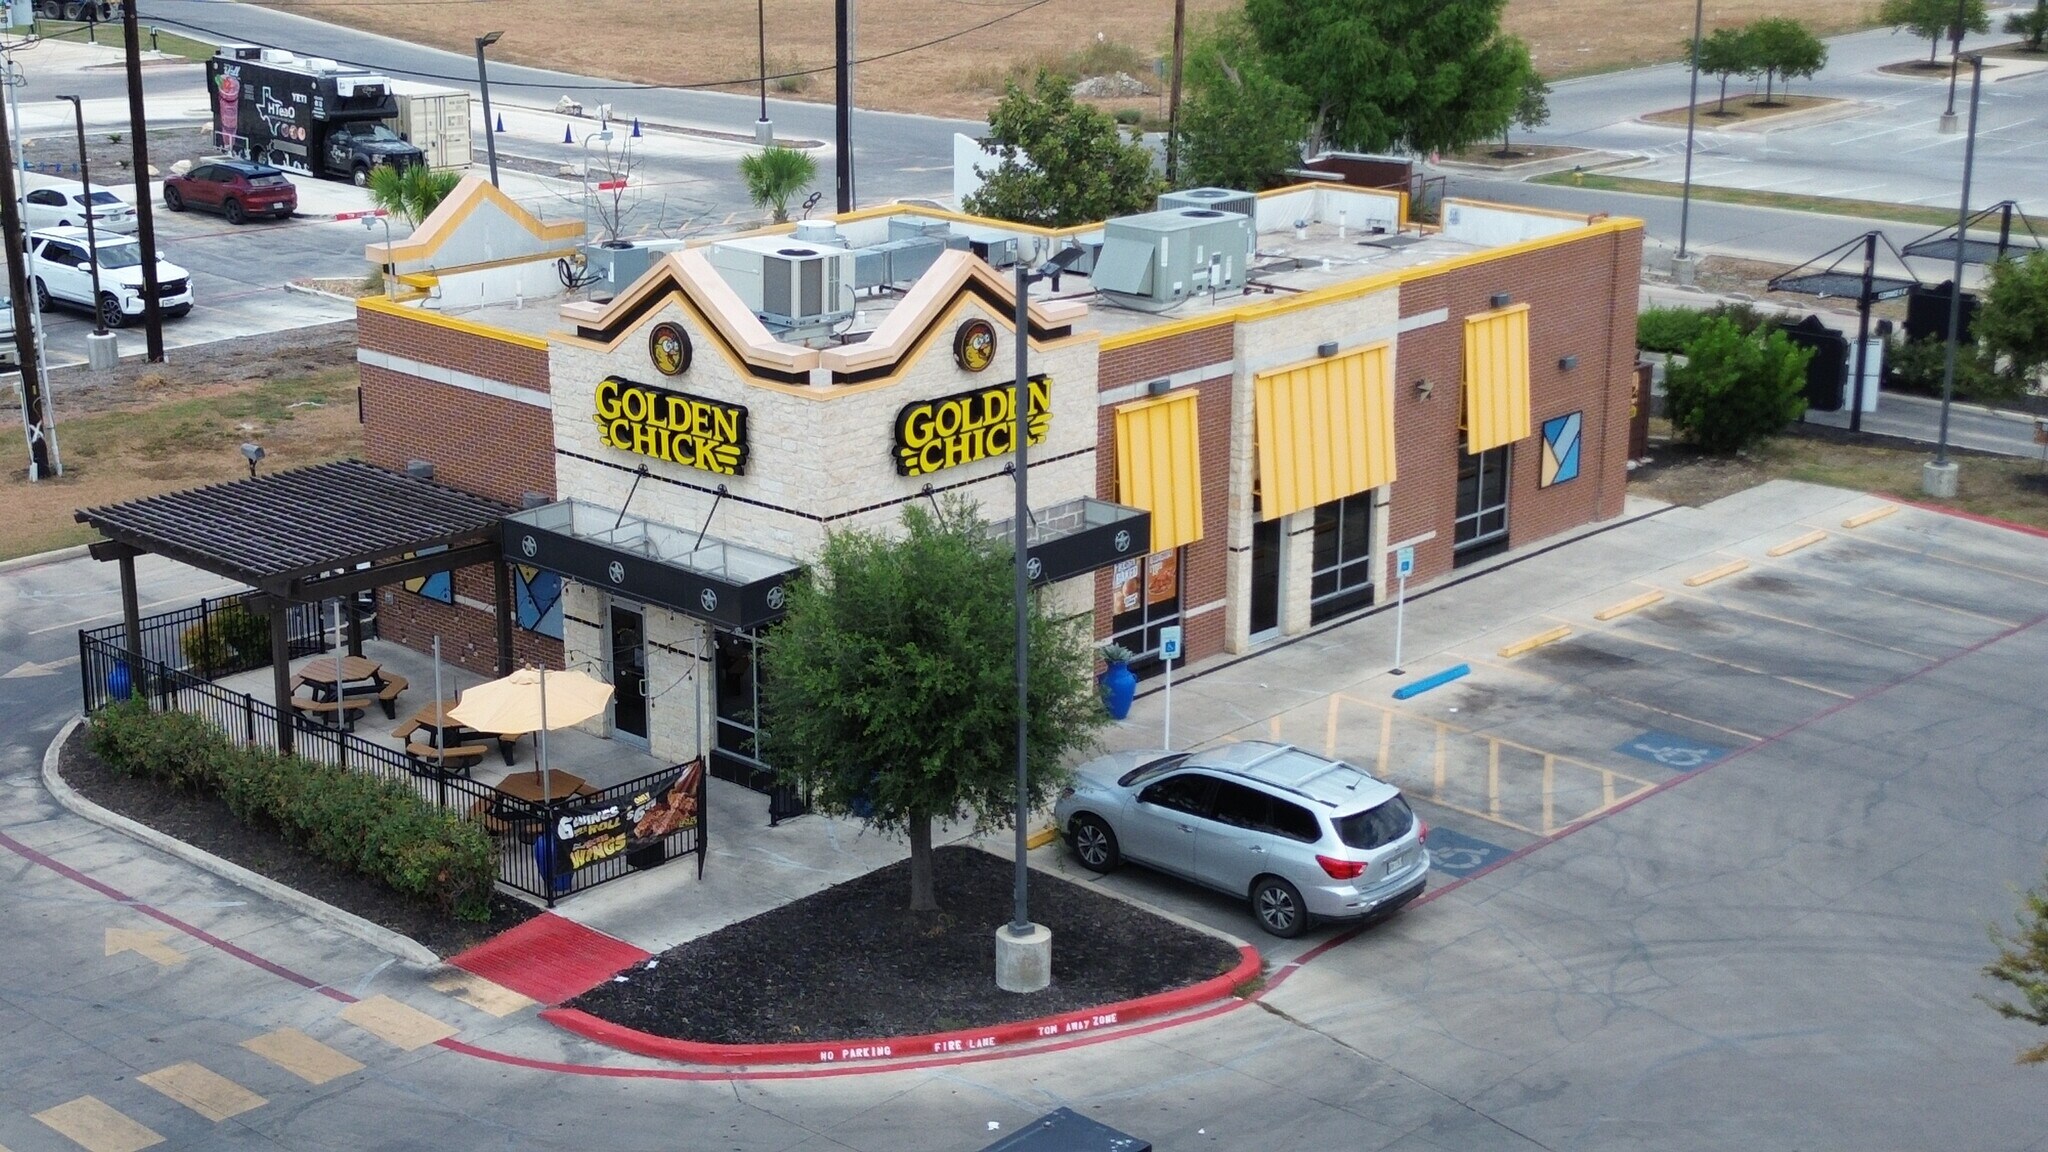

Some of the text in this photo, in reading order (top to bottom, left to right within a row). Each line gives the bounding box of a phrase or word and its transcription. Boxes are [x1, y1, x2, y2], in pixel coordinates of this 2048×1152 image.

[291, 92, 308, 104] YETI
[267, 101, 296, 119] HTeaO
[595, 380, 739, 443] GOLDEN
[609, 418, 723, 474] CHICK
[557, 816, 575, 840] 6
[573, 805, 620, 828] WINGS
[588, 816, 622, 836] ROLL
[570, 832, 627, 870] WINGS
[1038, 1013, 1117, 1036] TOW AWAY ZONE
[820, 1045, 892, 1061] NO PARKING
[934, 1036, 996, 1052] FIRE LANE
